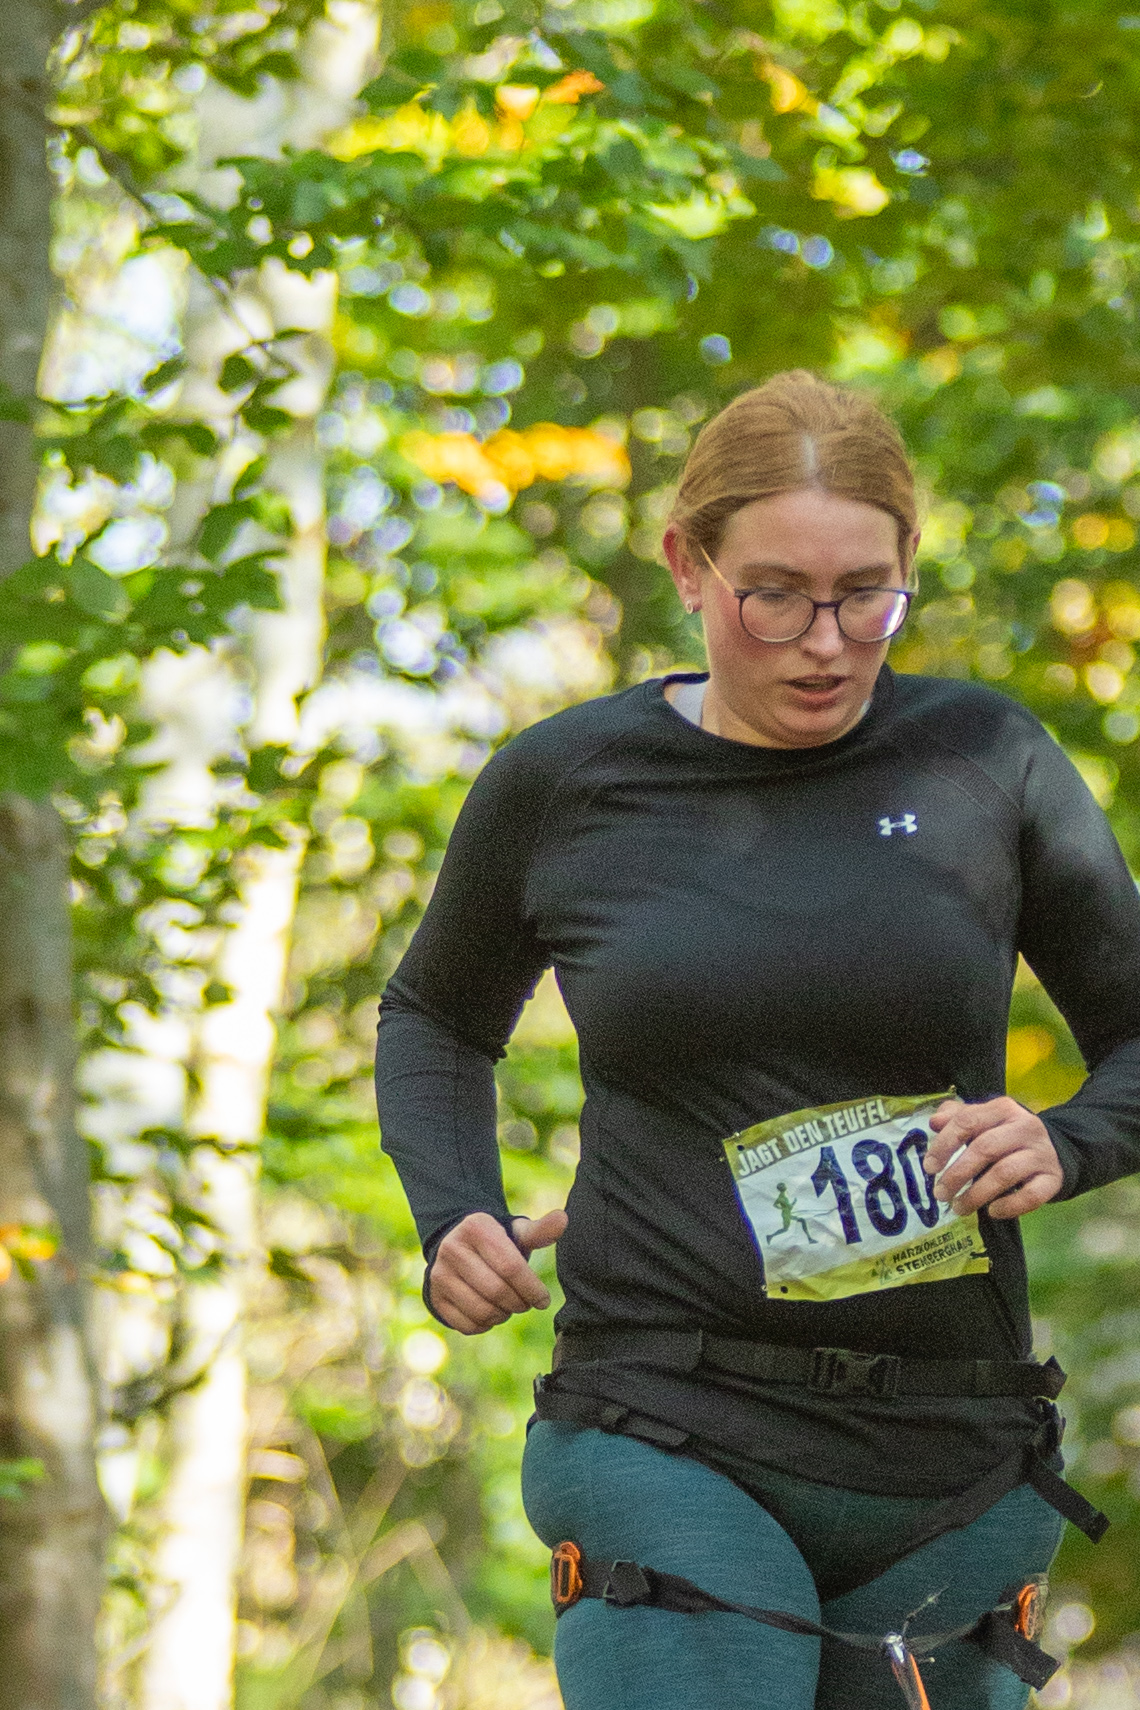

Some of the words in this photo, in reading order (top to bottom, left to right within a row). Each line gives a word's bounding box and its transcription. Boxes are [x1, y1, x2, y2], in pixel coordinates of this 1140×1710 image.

[738, 1138, 782, 1177] JAGT
[783, 1119, 825, 1154] DEN
[822, 1099, 891, 1139] TEUFEL
[811, 1127, 940, 1245] 180
